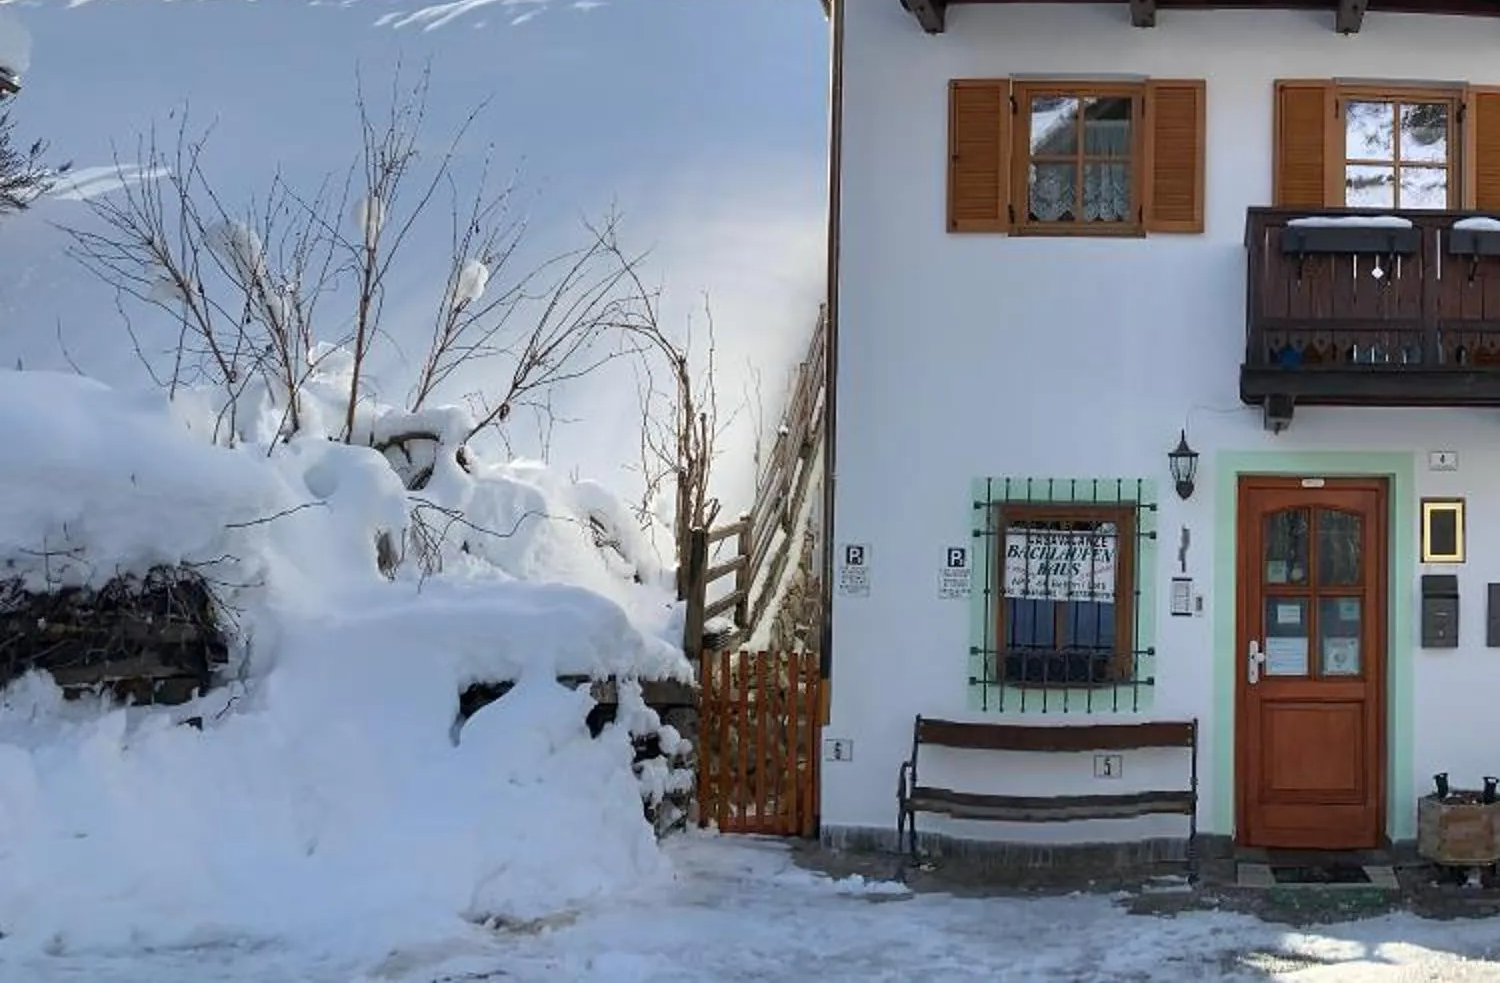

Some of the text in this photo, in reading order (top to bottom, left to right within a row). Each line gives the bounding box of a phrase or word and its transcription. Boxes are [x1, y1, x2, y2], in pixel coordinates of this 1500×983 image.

[848, 547, 861, 564] P
[949, 549, 962, 566] P
[1104, 757, 1111, 775] 5
